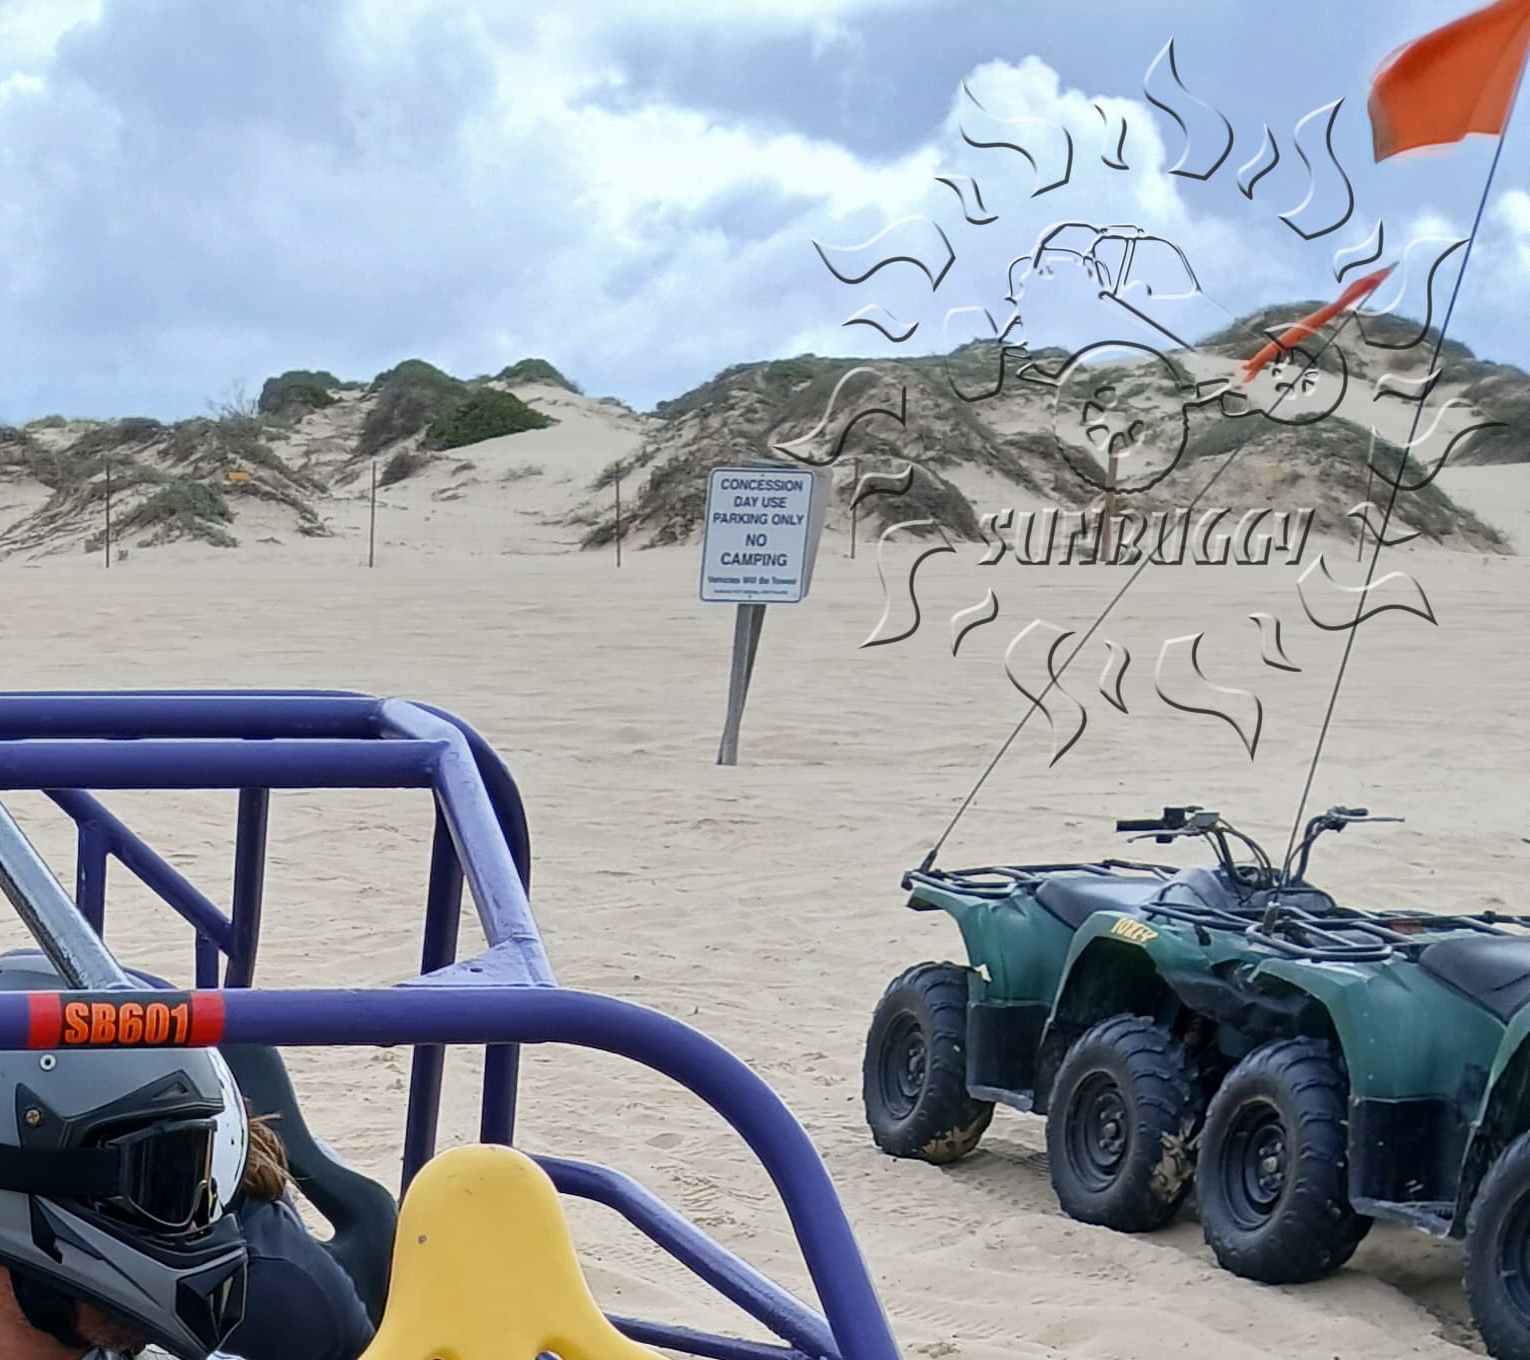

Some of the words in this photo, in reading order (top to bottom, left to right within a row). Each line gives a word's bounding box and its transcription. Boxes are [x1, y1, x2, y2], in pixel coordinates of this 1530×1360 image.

[721, 478, 804, 492] CONCESSION
[734, 496, 758, 507] DAY
[762, 497, 787, 508] USE
[713, 512, 768, 524] PARKING
[771, 513, 805, 525] ONLY
[745, 533, 768, 547] NO
[721, 552, 788, 566] CAMPING
[64, 1002, 189, 1044] SB601
